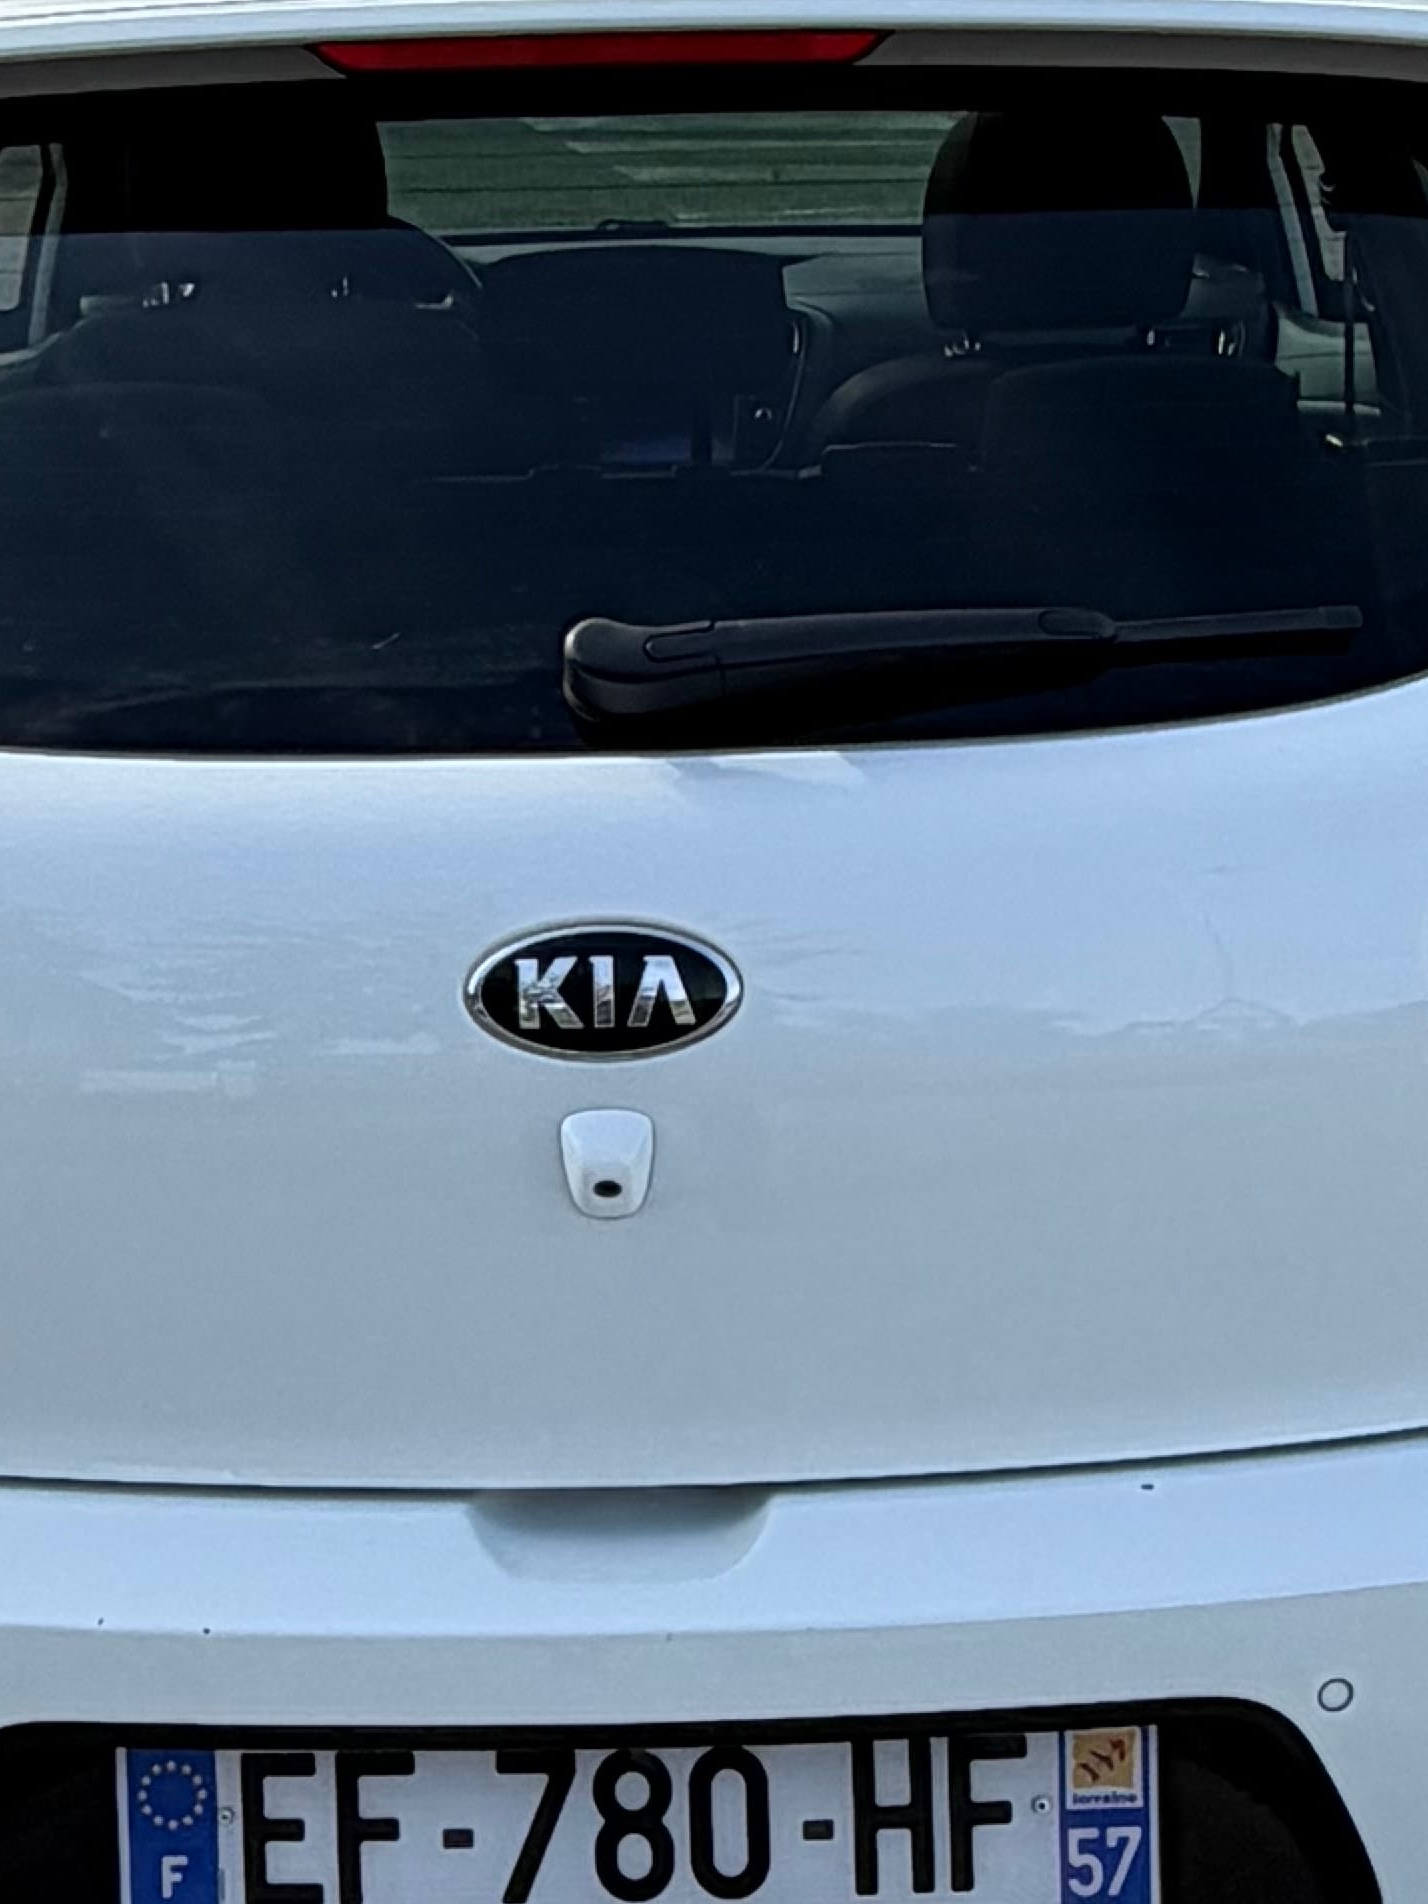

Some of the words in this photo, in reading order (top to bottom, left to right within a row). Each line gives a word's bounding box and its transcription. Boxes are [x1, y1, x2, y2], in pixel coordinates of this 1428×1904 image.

[514, 954, 697, 1030] KIA
[160, 1854, 189, 1900] F
[1067, 1826, 1142, 1897] 57
